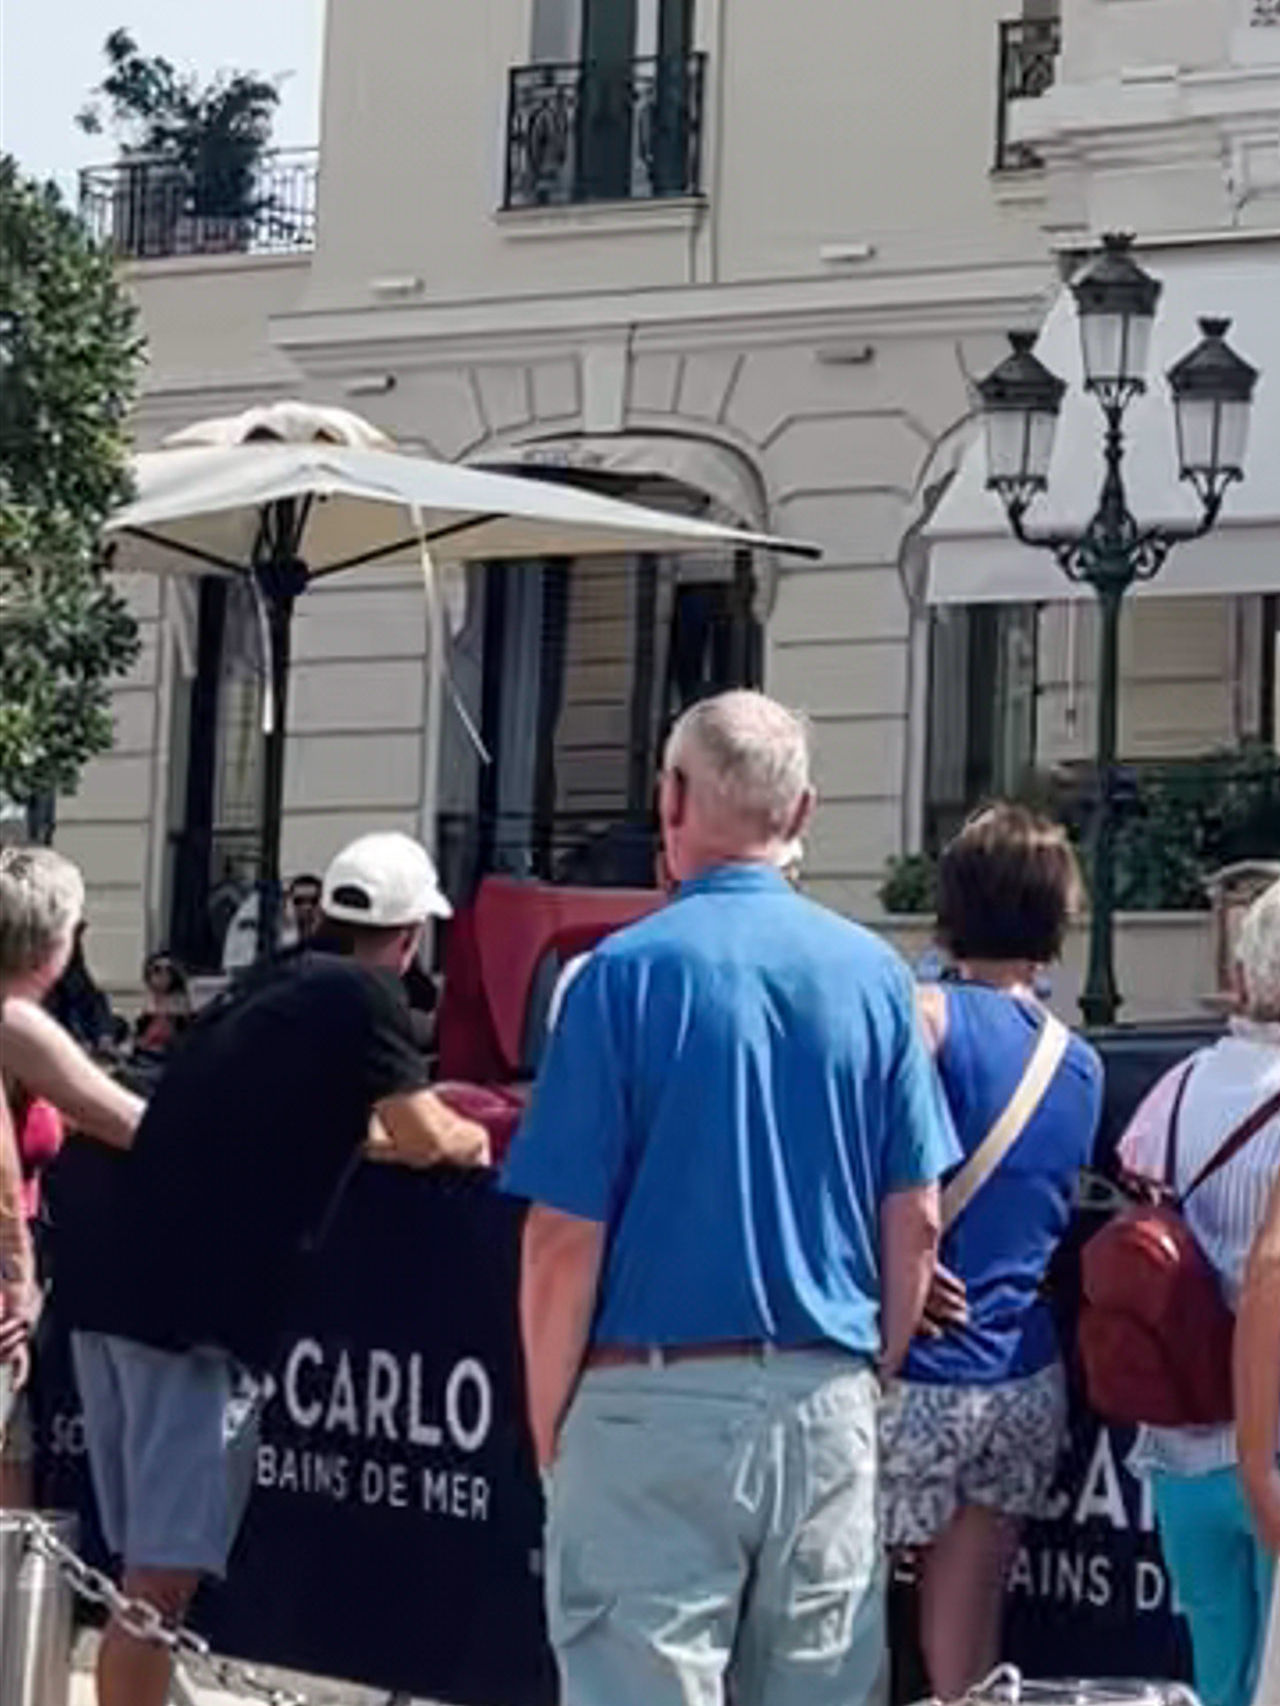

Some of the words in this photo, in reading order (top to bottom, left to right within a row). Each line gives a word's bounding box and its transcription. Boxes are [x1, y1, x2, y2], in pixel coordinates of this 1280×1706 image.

[284, 1338, 492, 1453] CARLO
[256, 1443, 350, 1500] BAINS
[363, 1460, 408, 1508] DE
[424, 1468, 490, 1521] MER
[1006, 1547, 1112, 1606] AINS
